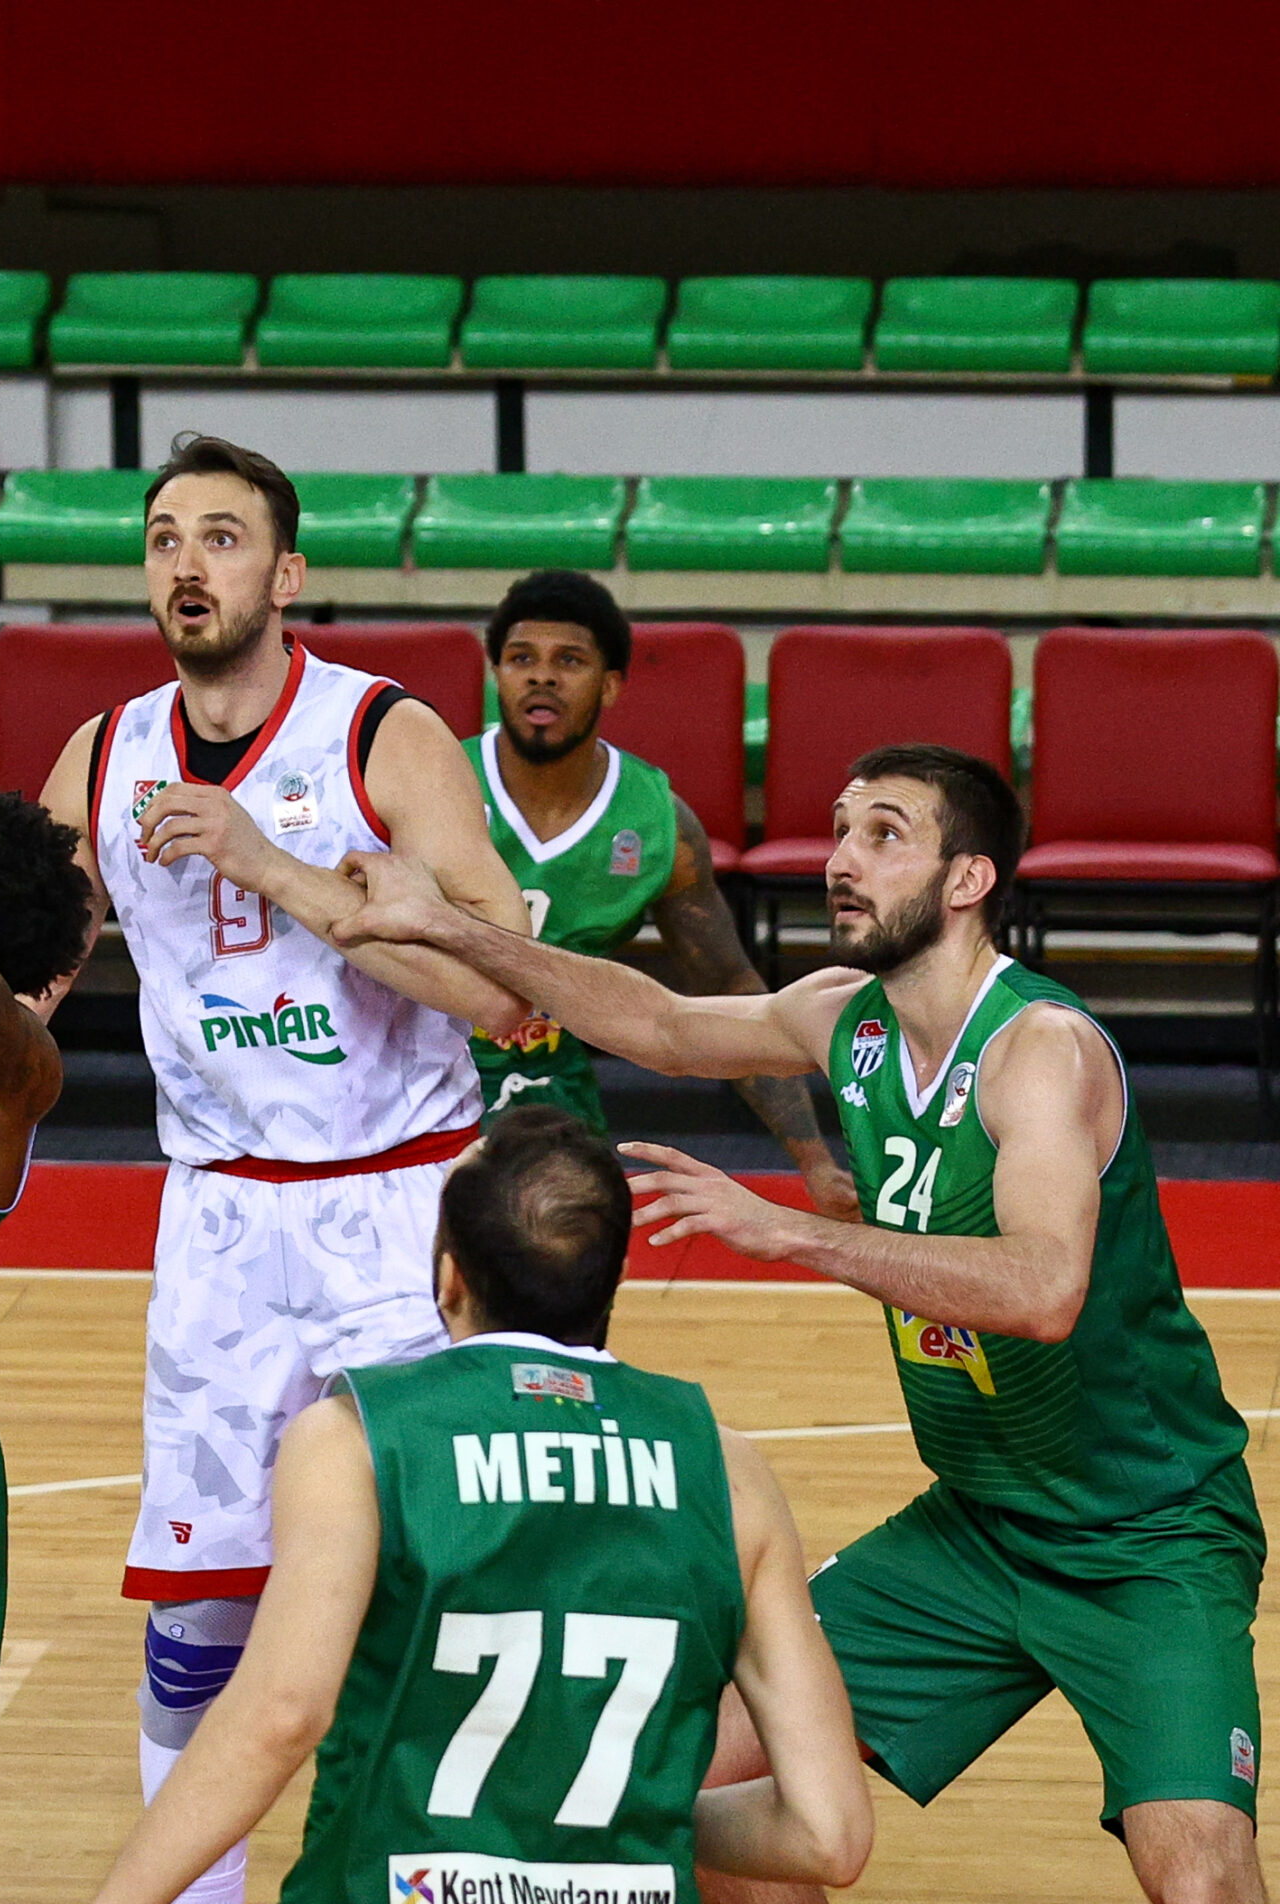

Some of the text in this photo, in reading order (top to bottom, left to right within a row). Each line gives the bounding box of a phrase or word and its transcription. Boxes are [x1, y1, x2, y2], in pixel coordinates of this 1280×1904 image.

[200, 1002, 337, 1052] PINAR
[876, 1136, 942, 1233] 24
[452, 1418, 678, 1511] METİN
[426, 1610, 680, 1828] 77
[441, 1868, 503, 1904] Kent
